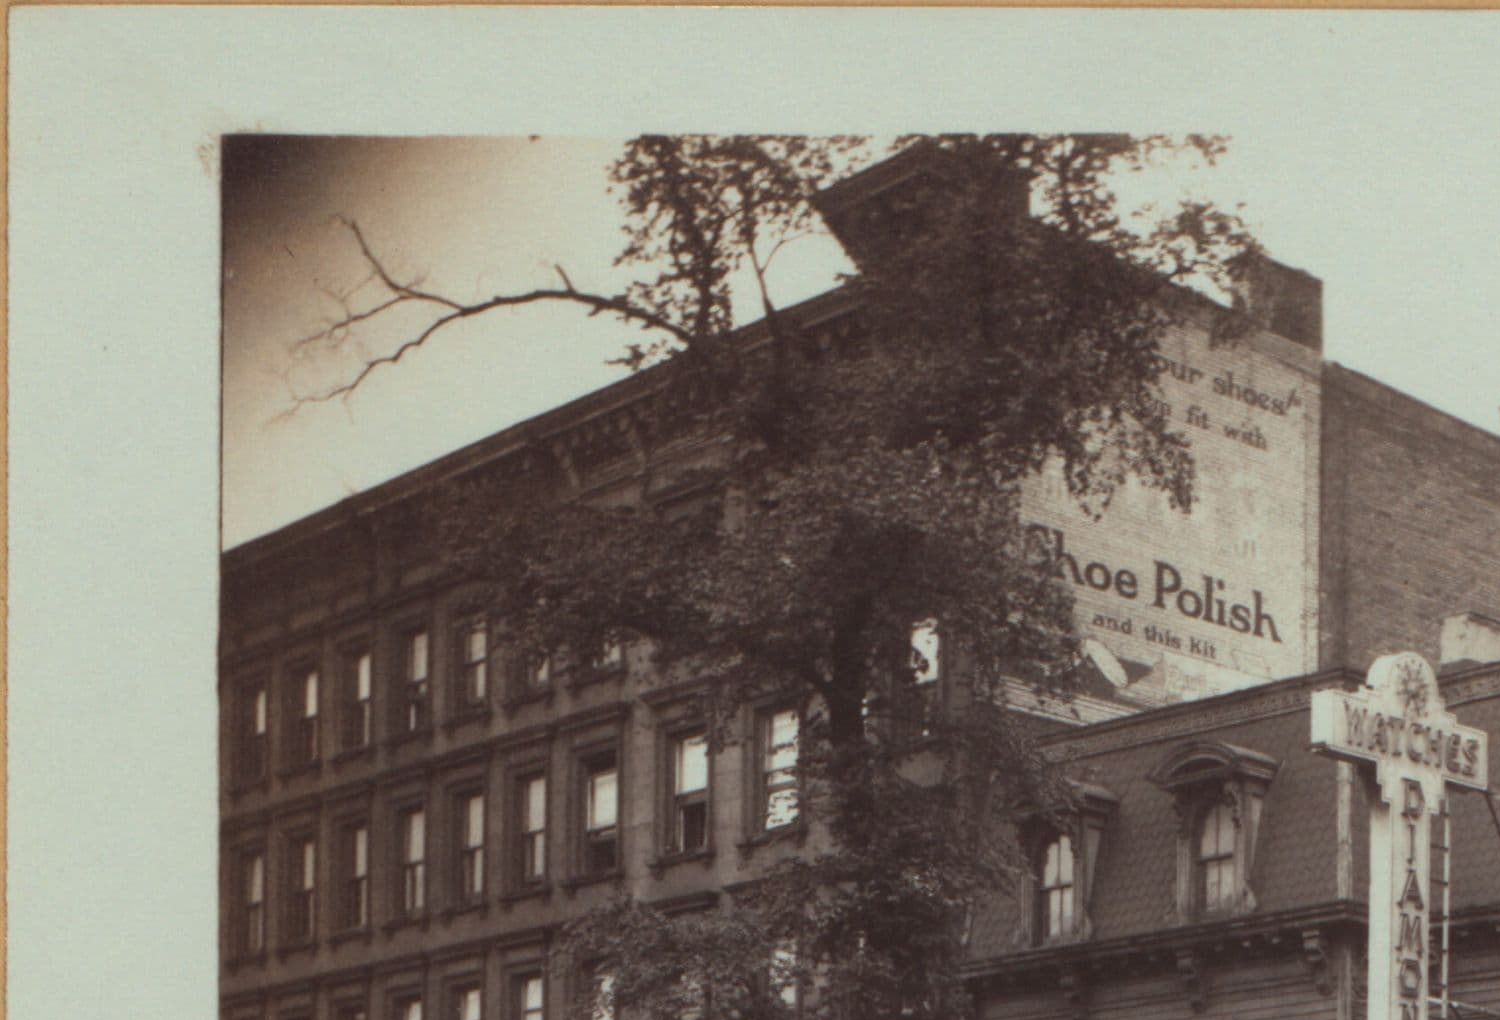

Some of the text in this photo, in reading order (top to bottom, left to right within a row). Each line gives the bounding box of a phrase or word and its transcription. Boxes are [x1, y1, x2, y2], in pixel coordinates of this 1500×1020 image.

[1224, 421, 1268, 451] with
[1026, 525, 1283, 644] Shoe Polish
[1092, 612, 1217, 659] and this Kit
[1343, 699, 1480, 776] WATCHES
